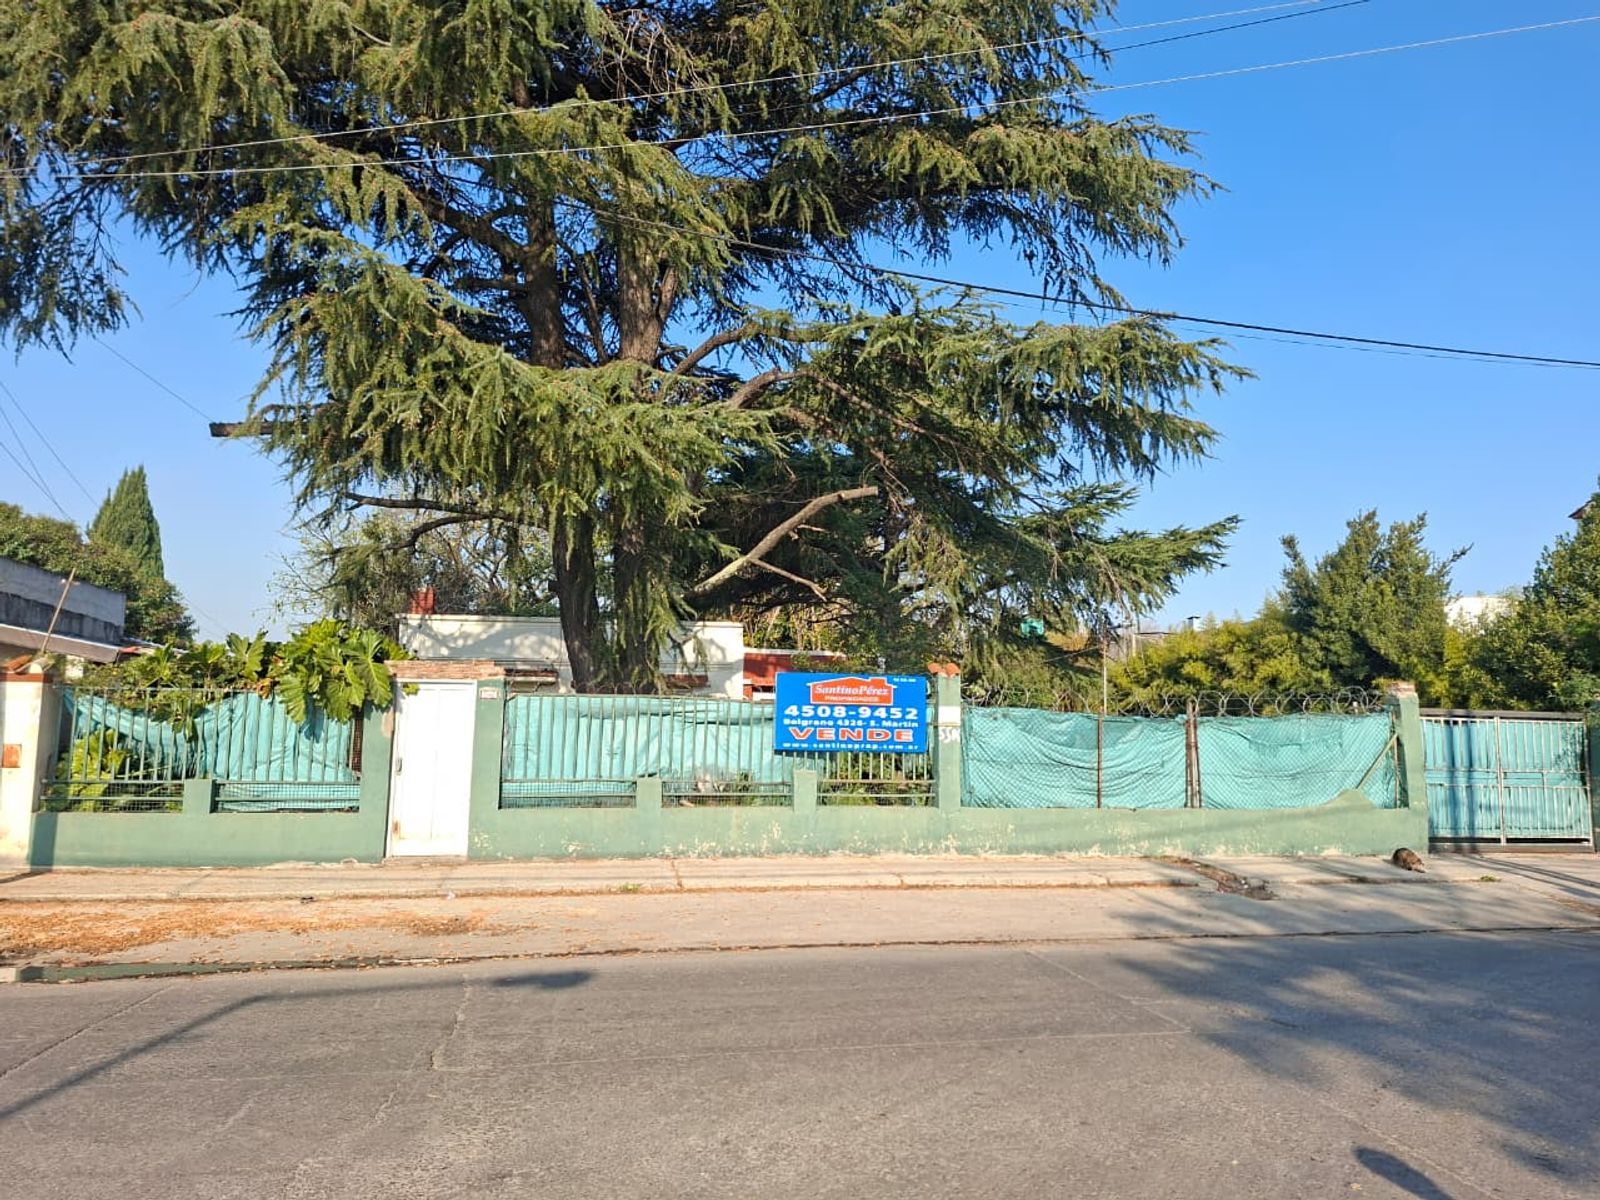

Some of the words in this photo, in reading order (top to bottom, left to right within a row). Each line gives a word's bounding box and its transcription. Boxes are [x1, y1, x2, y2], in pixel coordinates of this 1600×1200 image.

[784, 705, 919, 720] 4508-9452
[783, 718, 834, 727] Belgrano
[788, 727, 914, 743] VENDE
